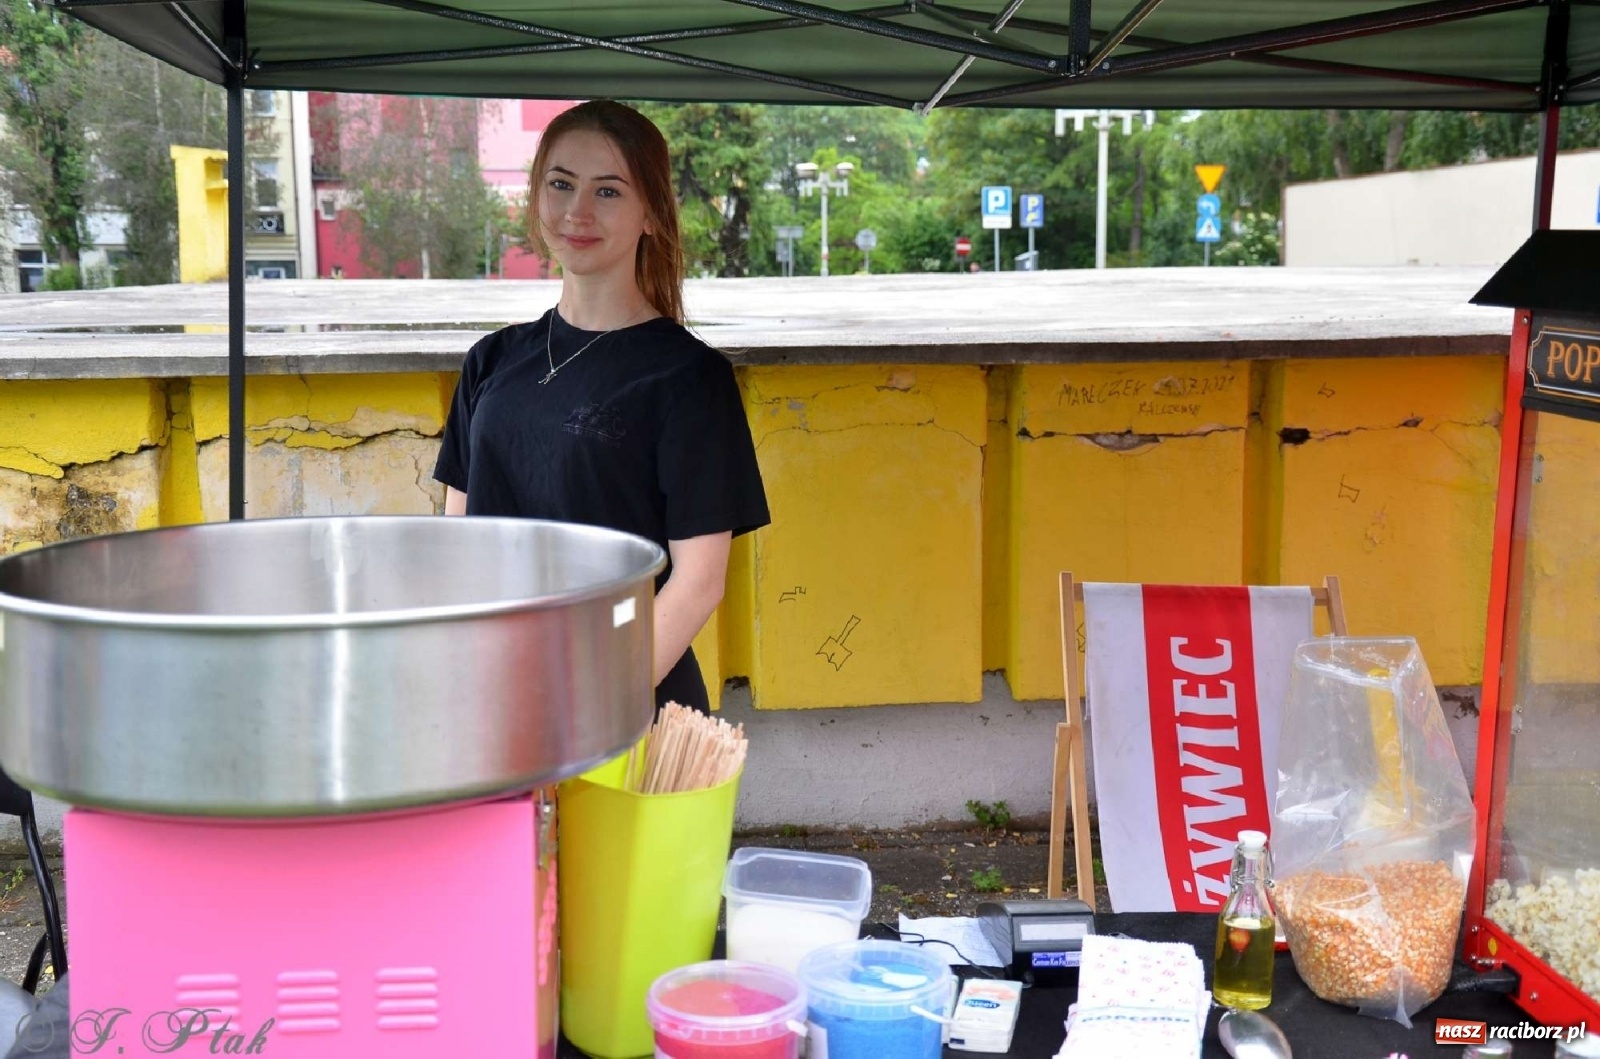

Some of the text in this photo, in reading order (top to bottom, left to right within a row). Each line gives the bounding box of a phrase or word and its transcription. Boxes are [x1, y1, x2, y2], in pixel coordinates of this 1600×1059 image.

[988, 190, 1006, 213] P
[1027, 196, 1040, 211] P
[1547, 340, 1600, 384] POP
[1170, 636, 1248, 906] ŻYWIEC
